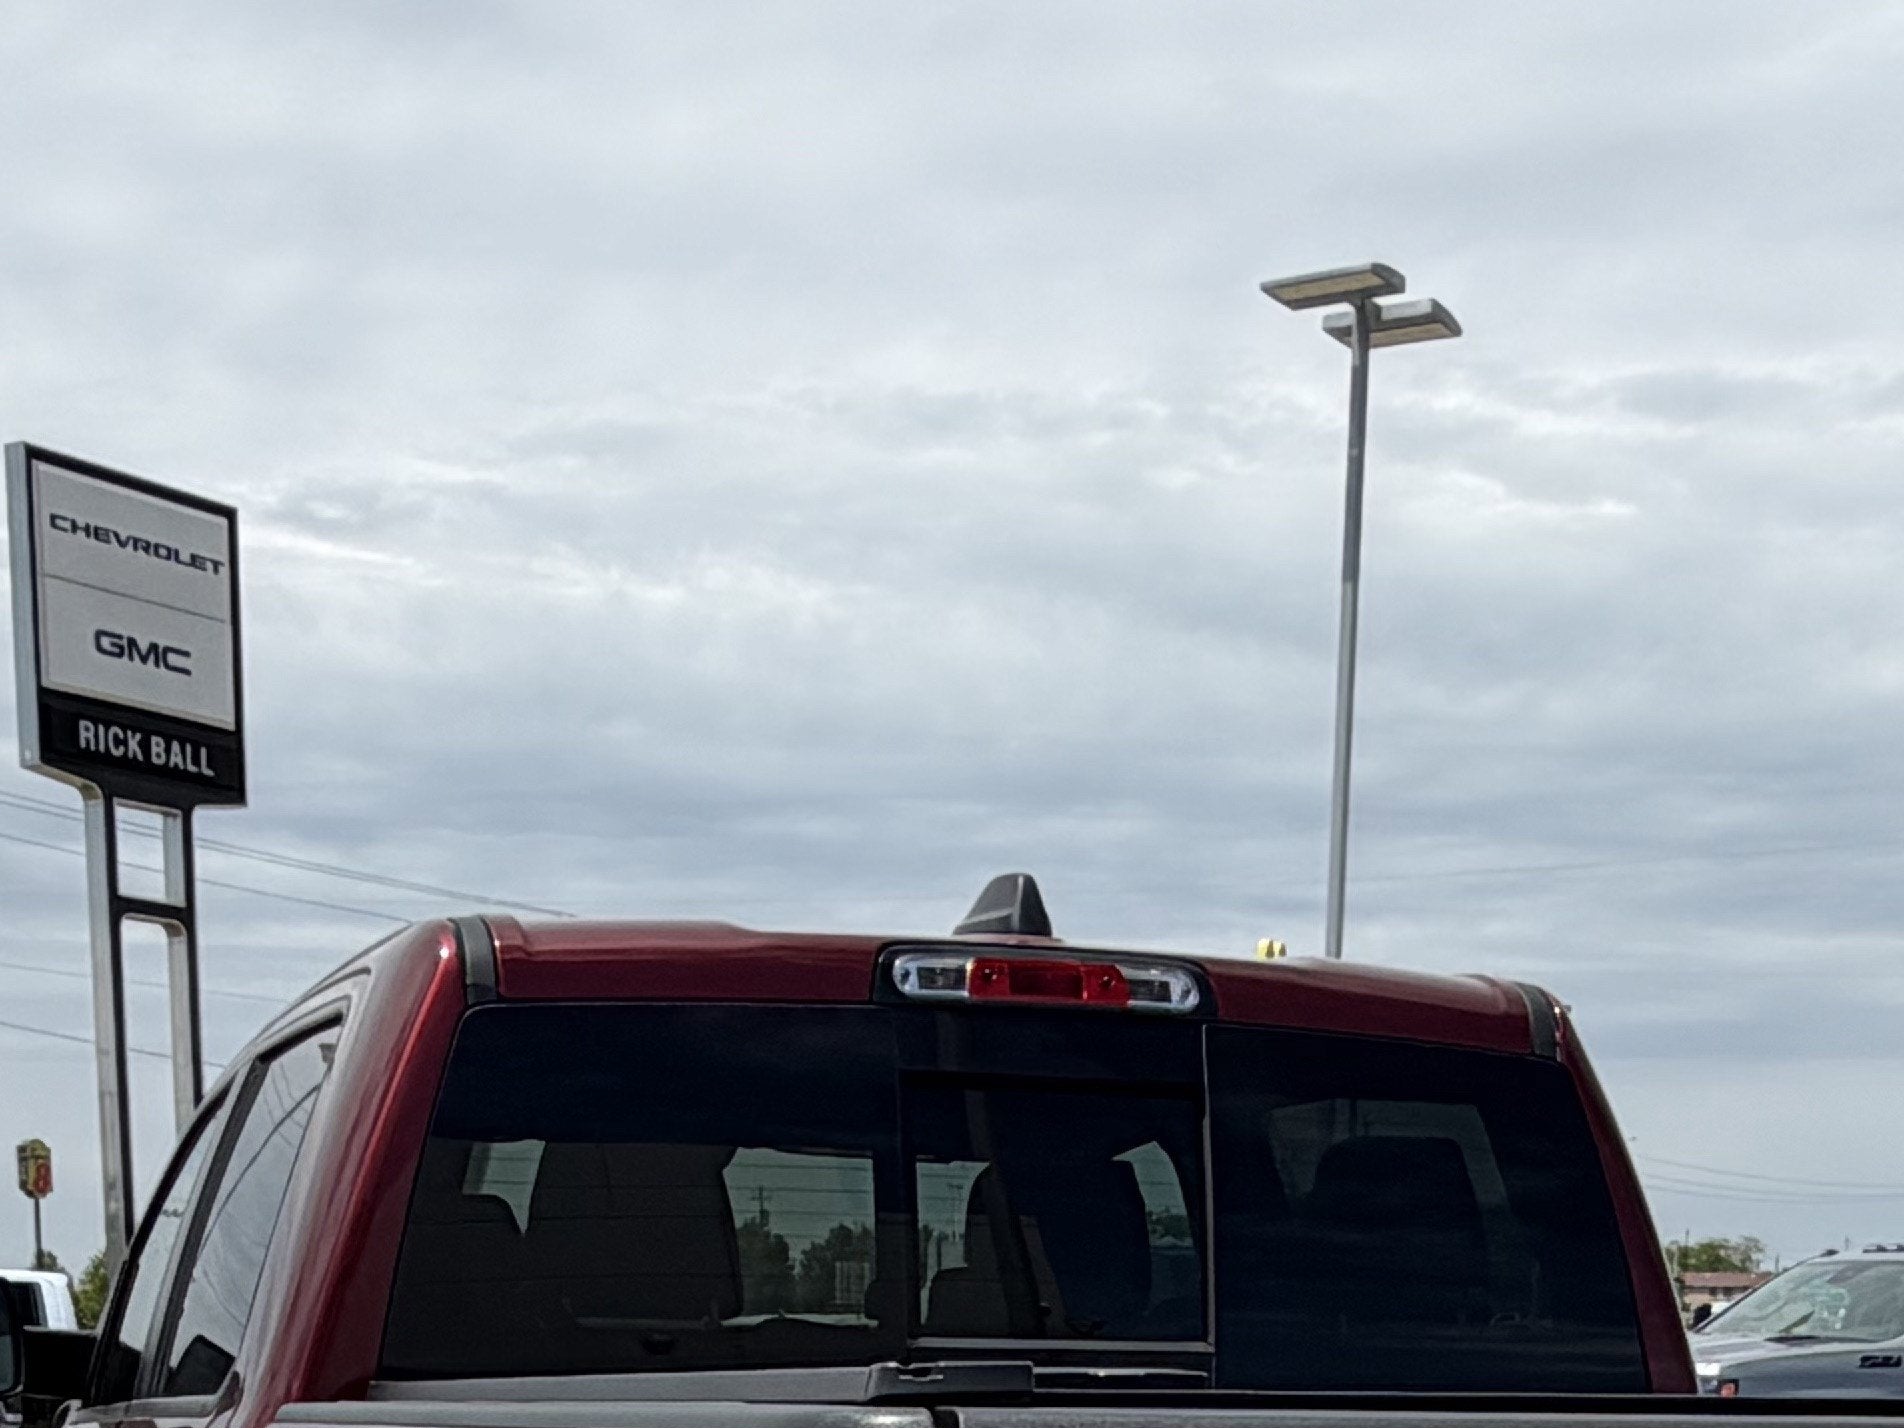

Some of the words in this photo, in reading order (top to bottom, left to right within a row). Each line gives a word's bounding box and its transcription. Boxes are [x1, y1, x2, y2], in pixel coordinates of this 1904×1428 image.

[49, 512, 225, 575] CHEVROLET
[94, 628, 192, 676] GMC
[78, 719, 144, 762] RICK
[150, 736, 215, 777] BALL
